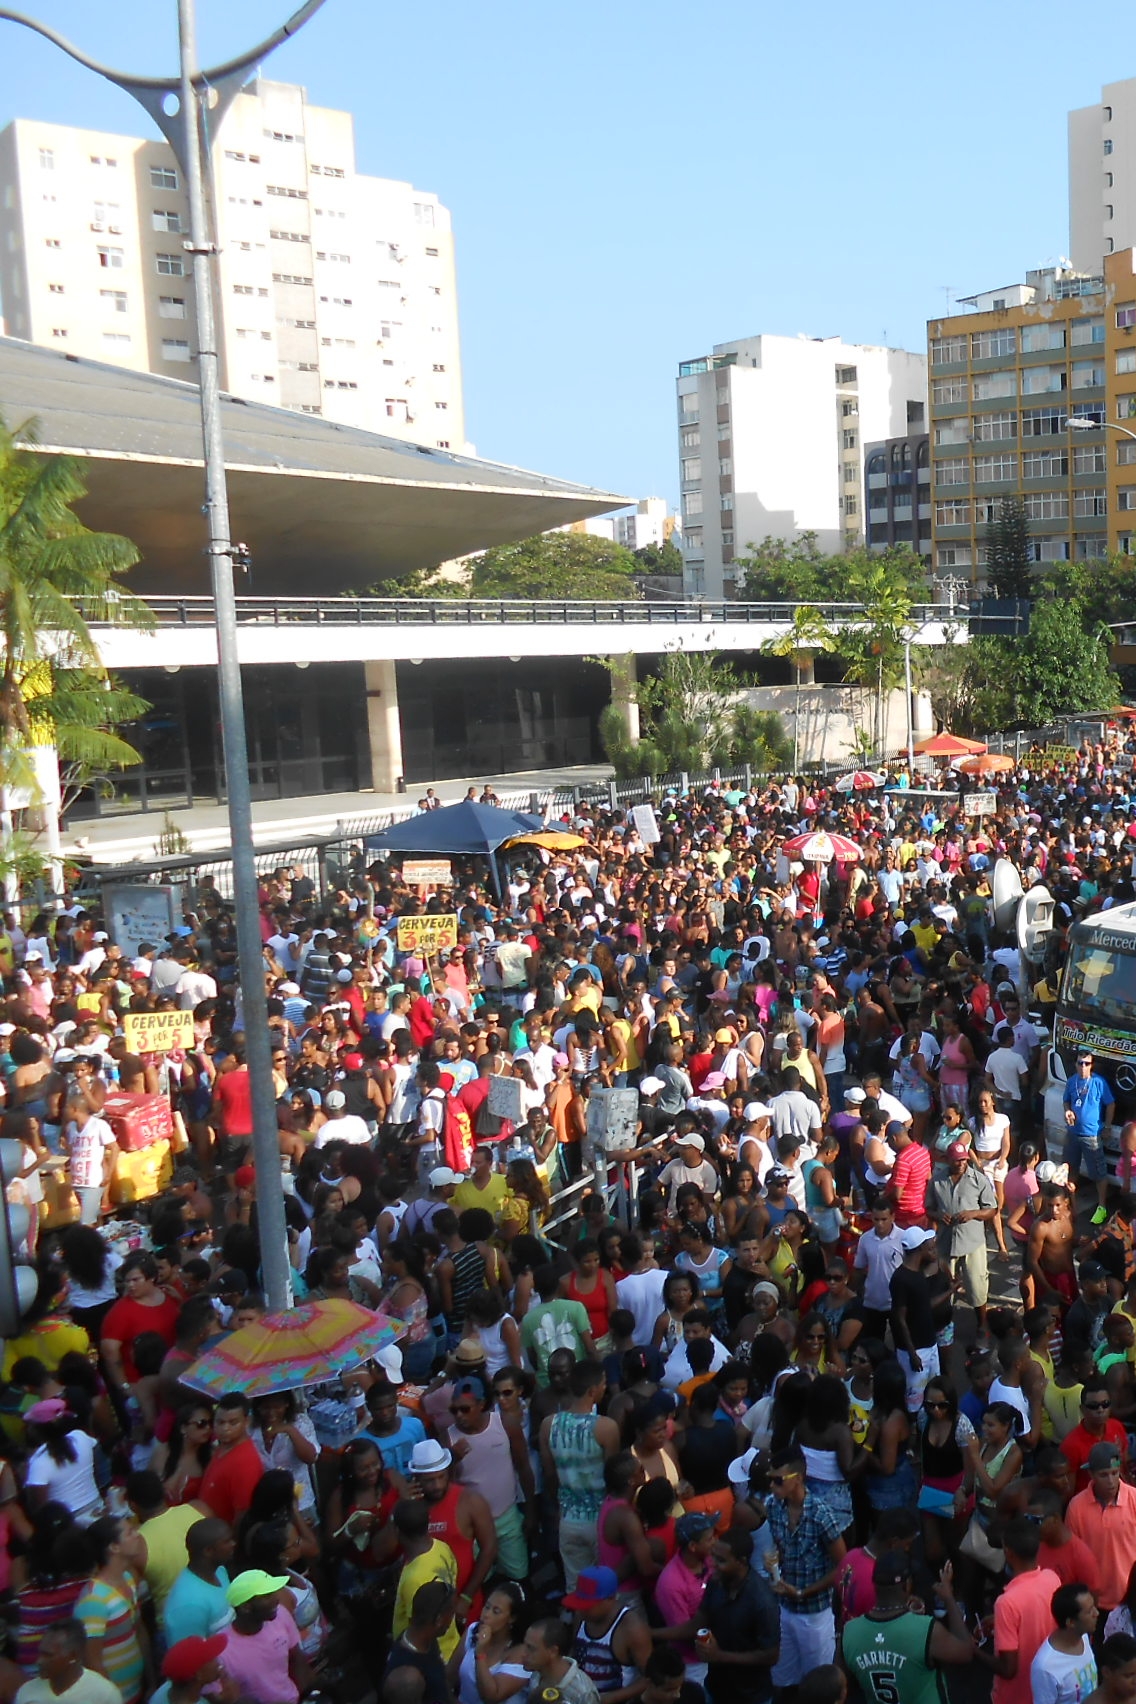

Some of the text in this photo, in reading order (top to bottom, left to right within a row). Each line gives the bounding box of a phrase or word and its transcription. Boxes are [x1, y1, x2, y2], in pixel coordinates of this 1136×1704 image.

[399, 917, 454, 930] CERVEJA
[402, 931, 451, 948] 3 POR 5
[131, 1014, 192, 1029] CERVEJA
[136, 1028, 183, 1049] 3 POR 5
[1063, 1026, 1085, 1042] Trio
[856, 1650, 907, 1670] GARNETT
[869, 1670, 901, 1704] 5
